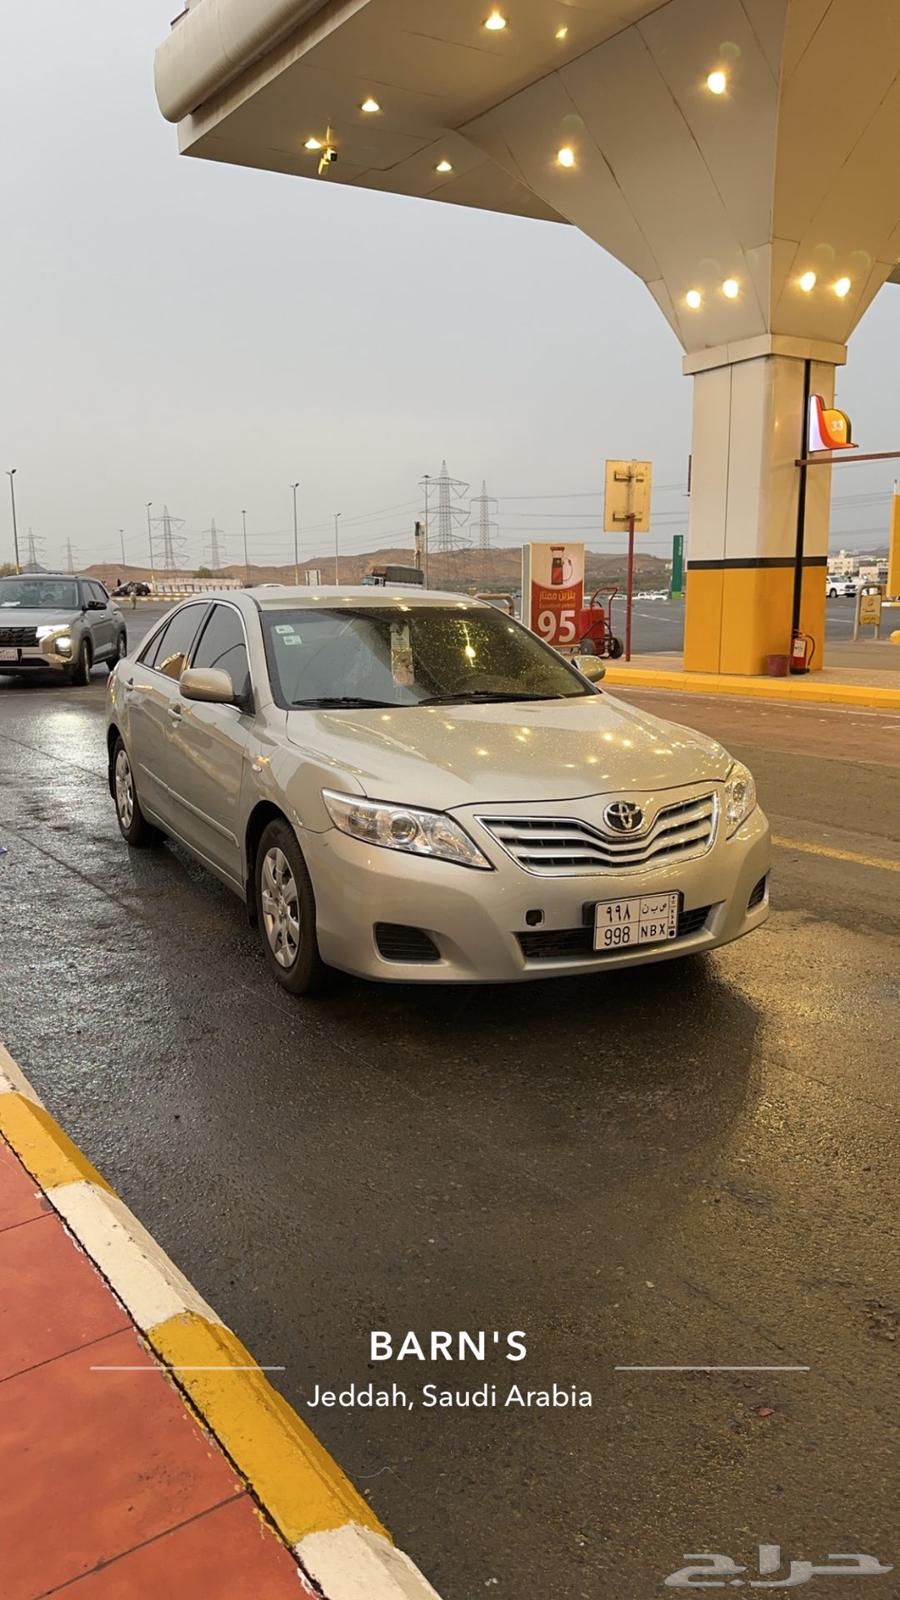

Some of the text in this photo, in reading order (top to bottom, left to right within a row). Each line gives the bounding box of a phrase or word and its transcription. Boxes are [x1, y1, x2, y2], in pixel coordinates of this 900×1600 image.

[537, 610, 576, 643] 95
[604, 923, 666, 946] 998 NBX
